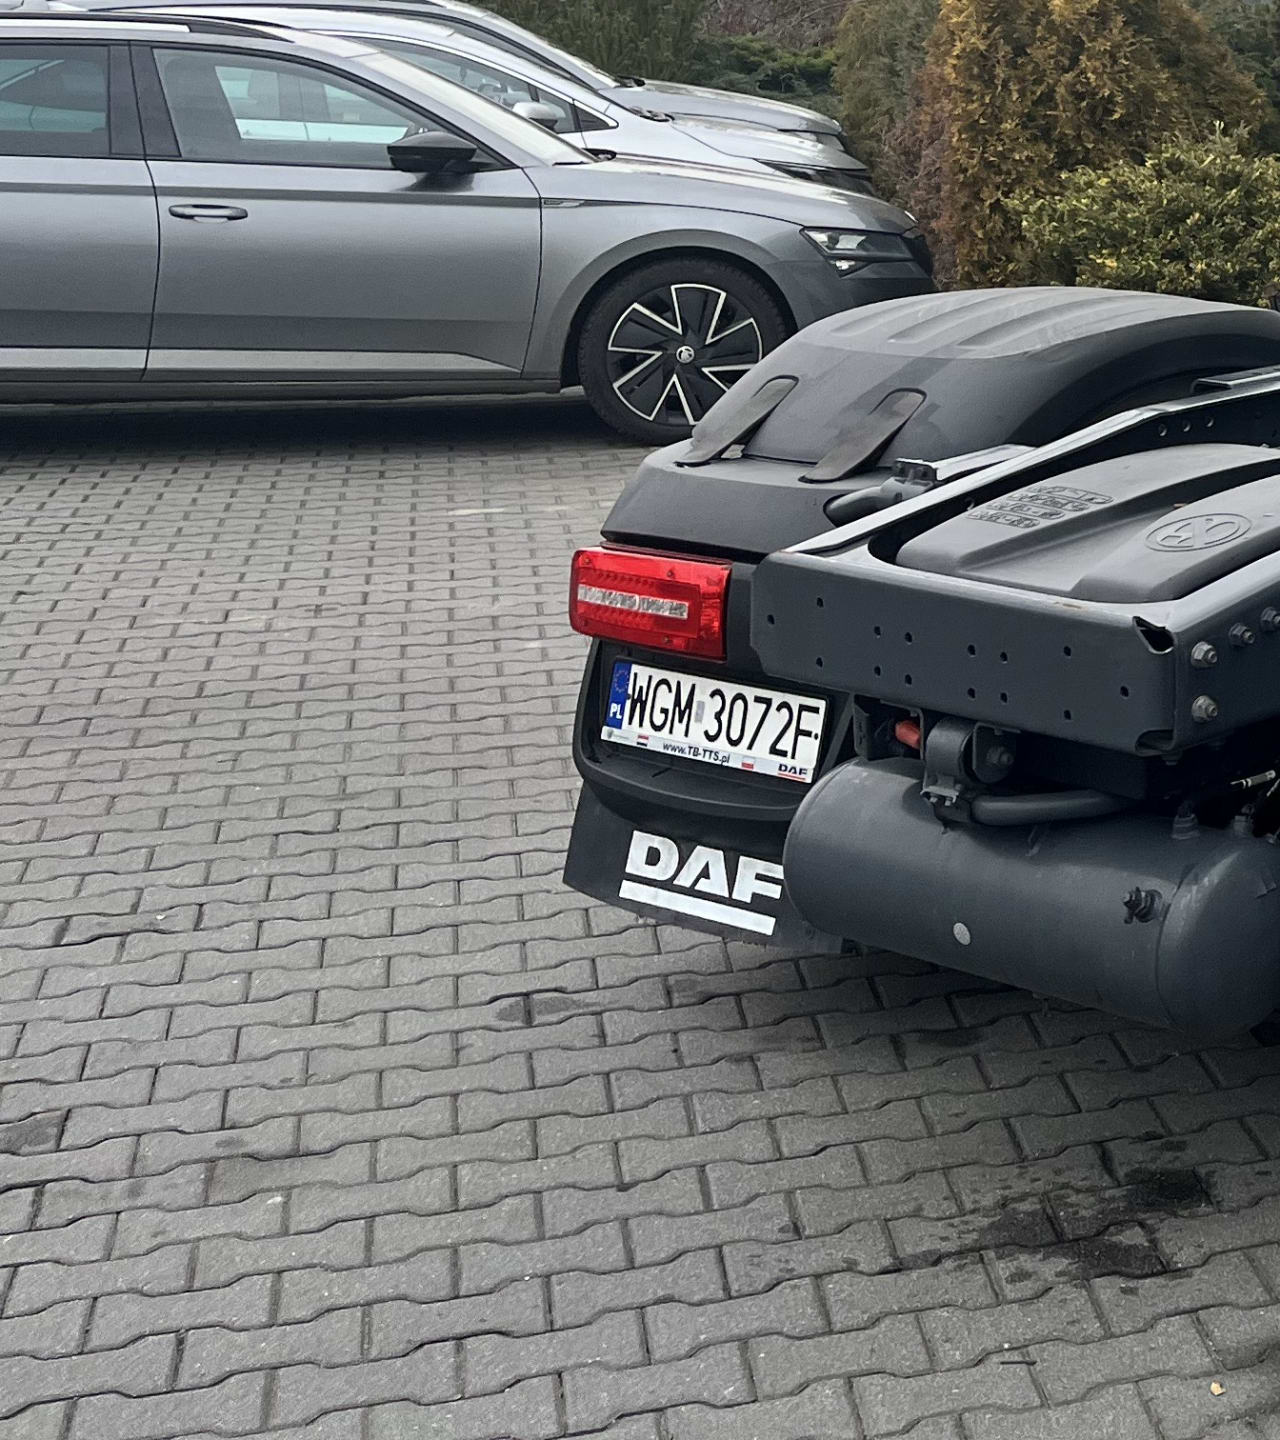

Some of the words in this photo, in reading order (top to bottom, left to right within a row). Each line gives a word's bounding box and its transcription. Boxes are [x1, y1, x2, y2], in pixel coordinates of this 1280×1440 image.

[609, 702, 623, 720] PL
[627, 672, 697, 738] WGM
[703, 688, 821, 760] 3072F
[662, 742, 731, 767] www.TB-TTS.pl
[777, 763, 809, 777] DAF
[625, 830, 785, 904] DAF
